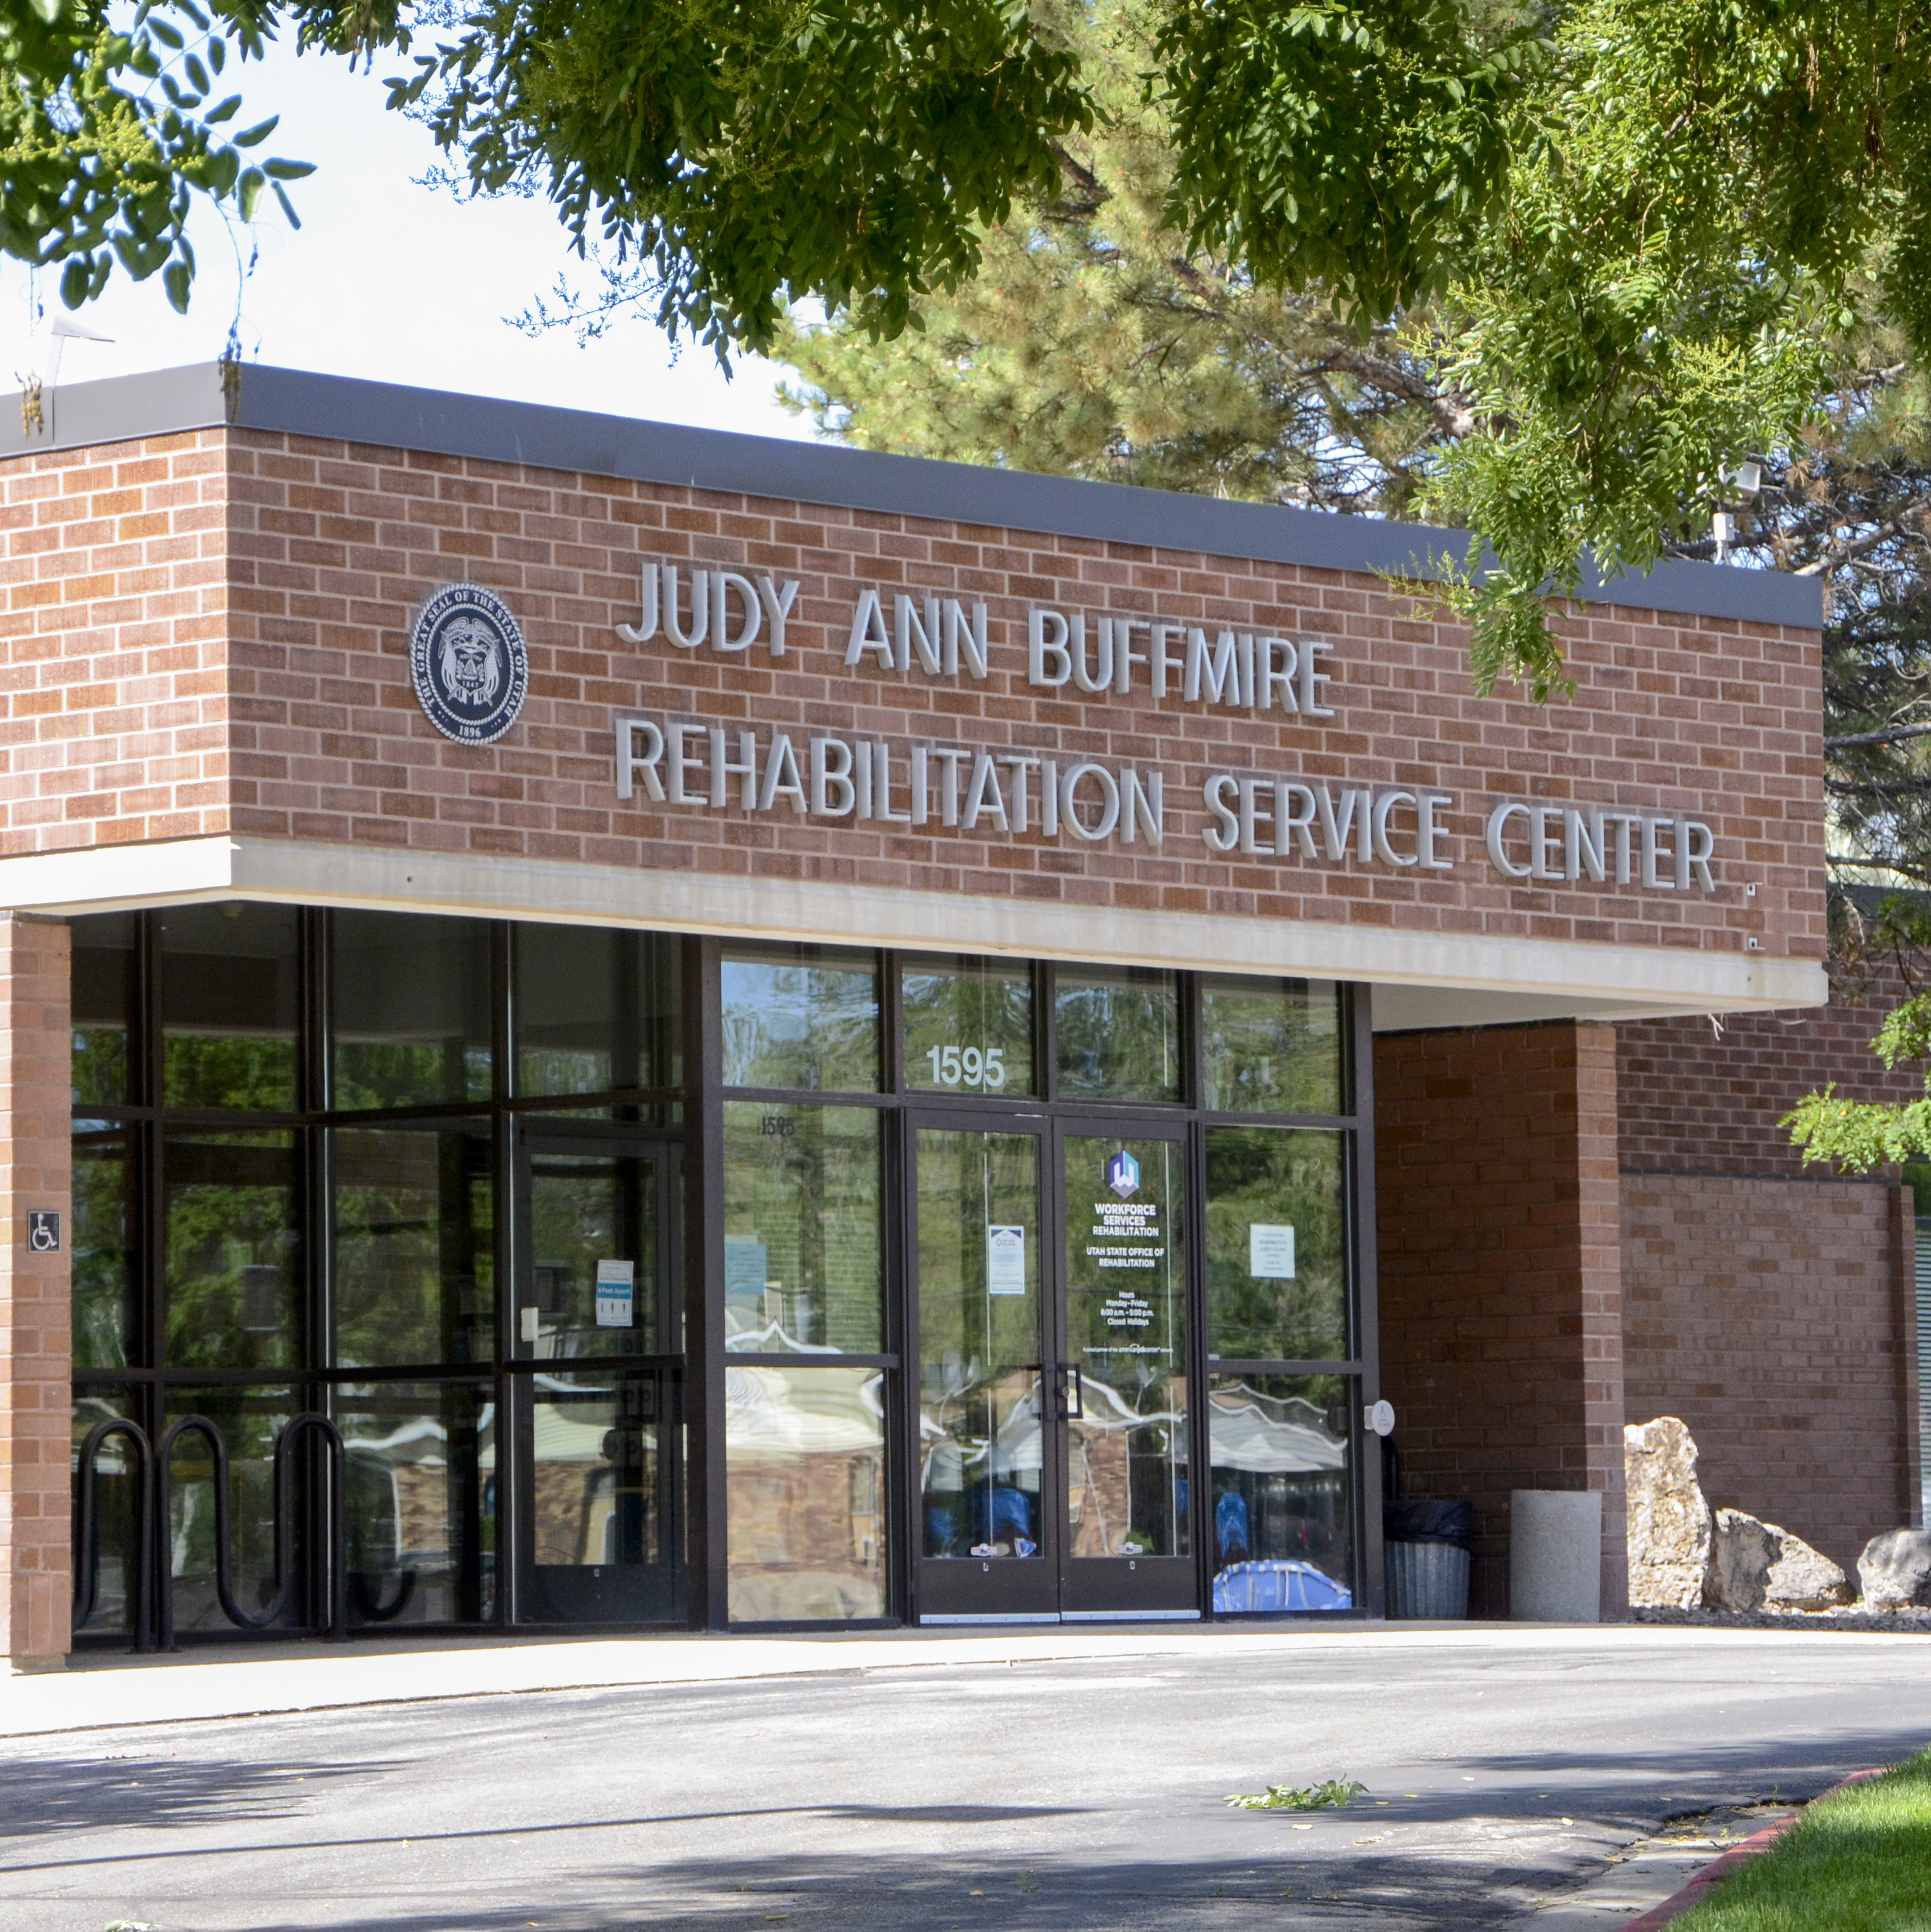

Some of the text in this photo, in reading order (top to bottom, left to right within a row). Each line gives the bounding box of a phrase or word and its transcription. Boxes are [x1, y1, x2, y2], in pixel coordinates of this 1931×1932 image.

[614, 563, 1335, 717] JUDY ANN BUFFMIRE
[416, 590, 524, 718] THE GREAT SEAL OF THE STATE OF UTAH
[458, 725, 481, 737] 1896
[615, 717, 1715, 893] REHABILITATION SERVICE CENTER
[927, 1045, 1005, 1087] 1595
[761, 1116, 795, 1136] 1595
[1095, 1203, 1157, 1216] WORKFORCE
[1103, 1215, 1146, 1226] SERVICES
[1092, 1225, 1159, 1237] REHABILITATION
[1086, 1246, 1165, 1257] UTAH STATE OFFICE OF
[1099, 1258, 1155, 1268] REHABILITATION
